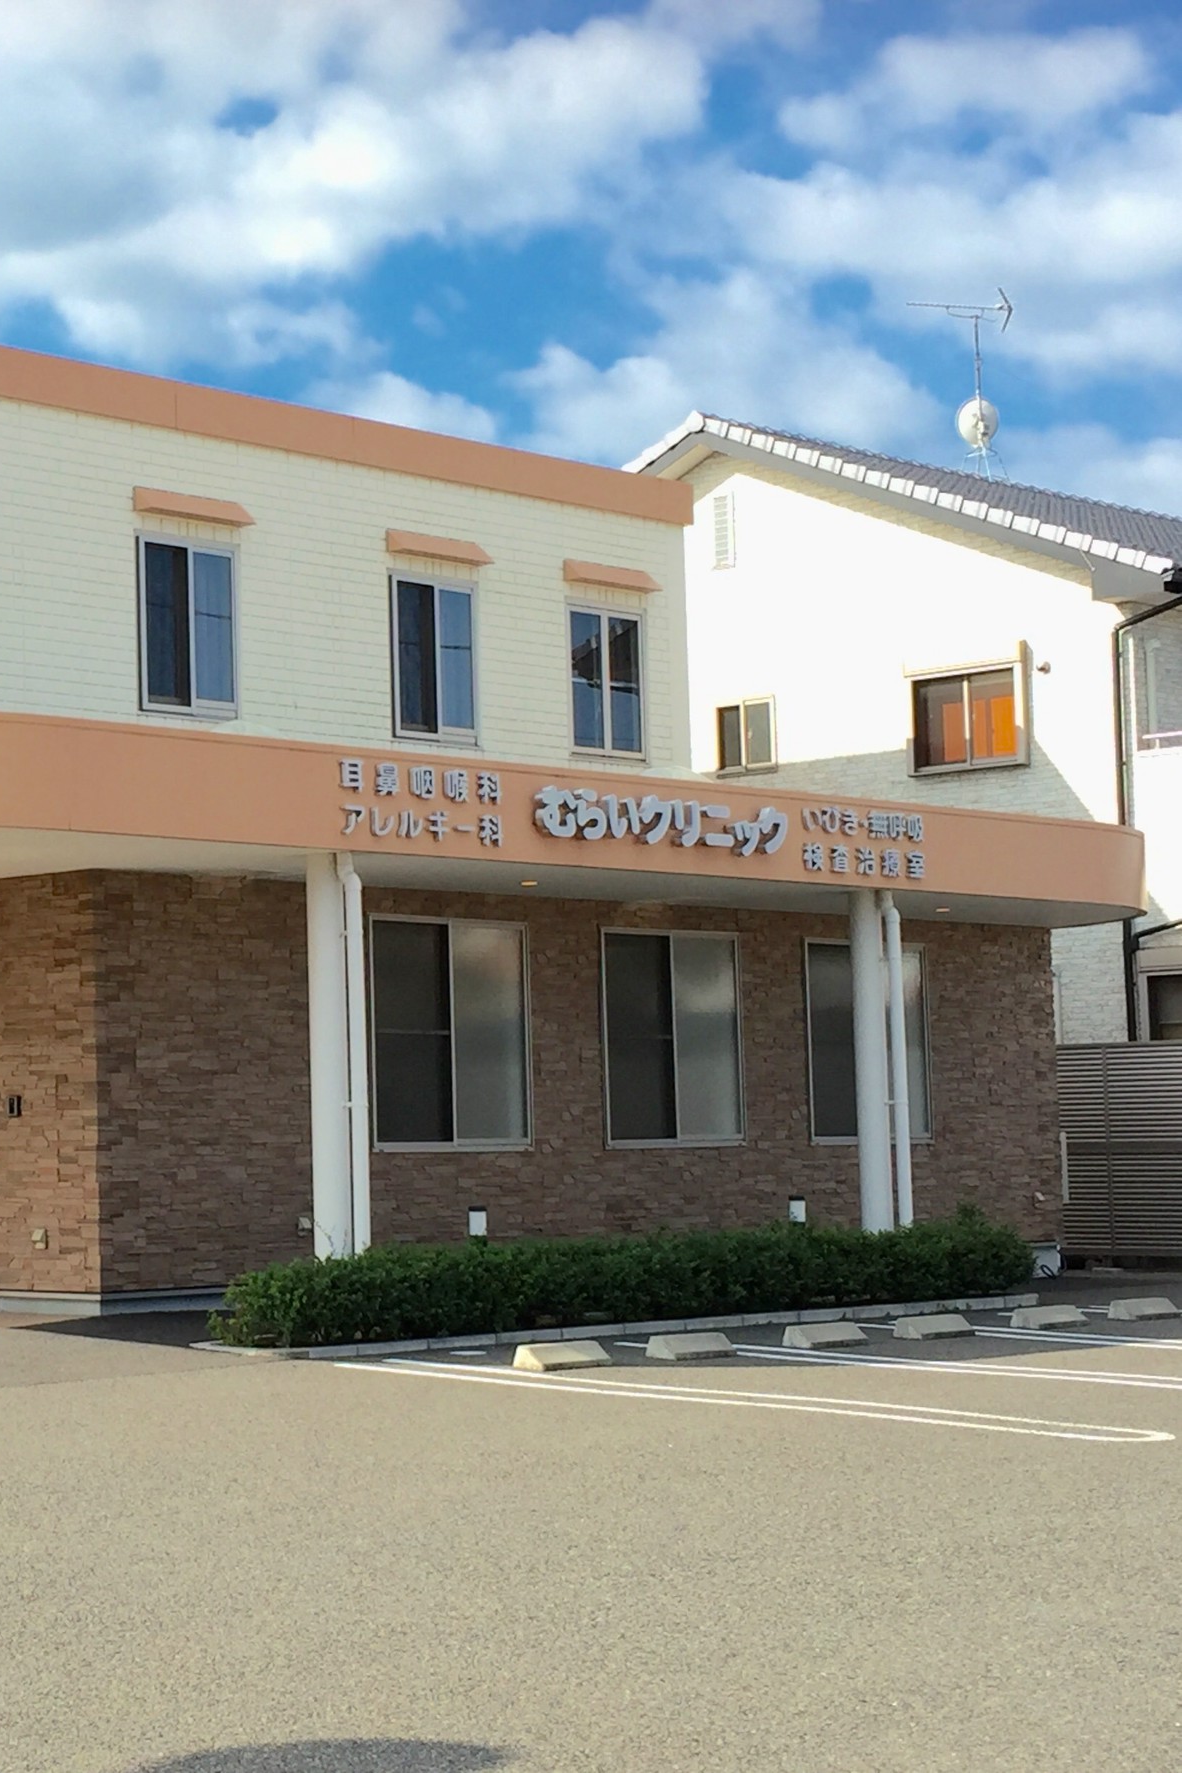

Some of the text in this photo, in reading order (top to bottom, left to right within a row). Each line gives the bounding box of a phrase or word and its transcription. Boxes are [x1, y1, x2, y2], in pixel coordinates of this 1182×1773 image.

[339, 759, 502, 804] 耳鼻咽喉科
[534, 785, 789, 857] むらいクリニック
[802, 842, 925, 879] 検査治療室
